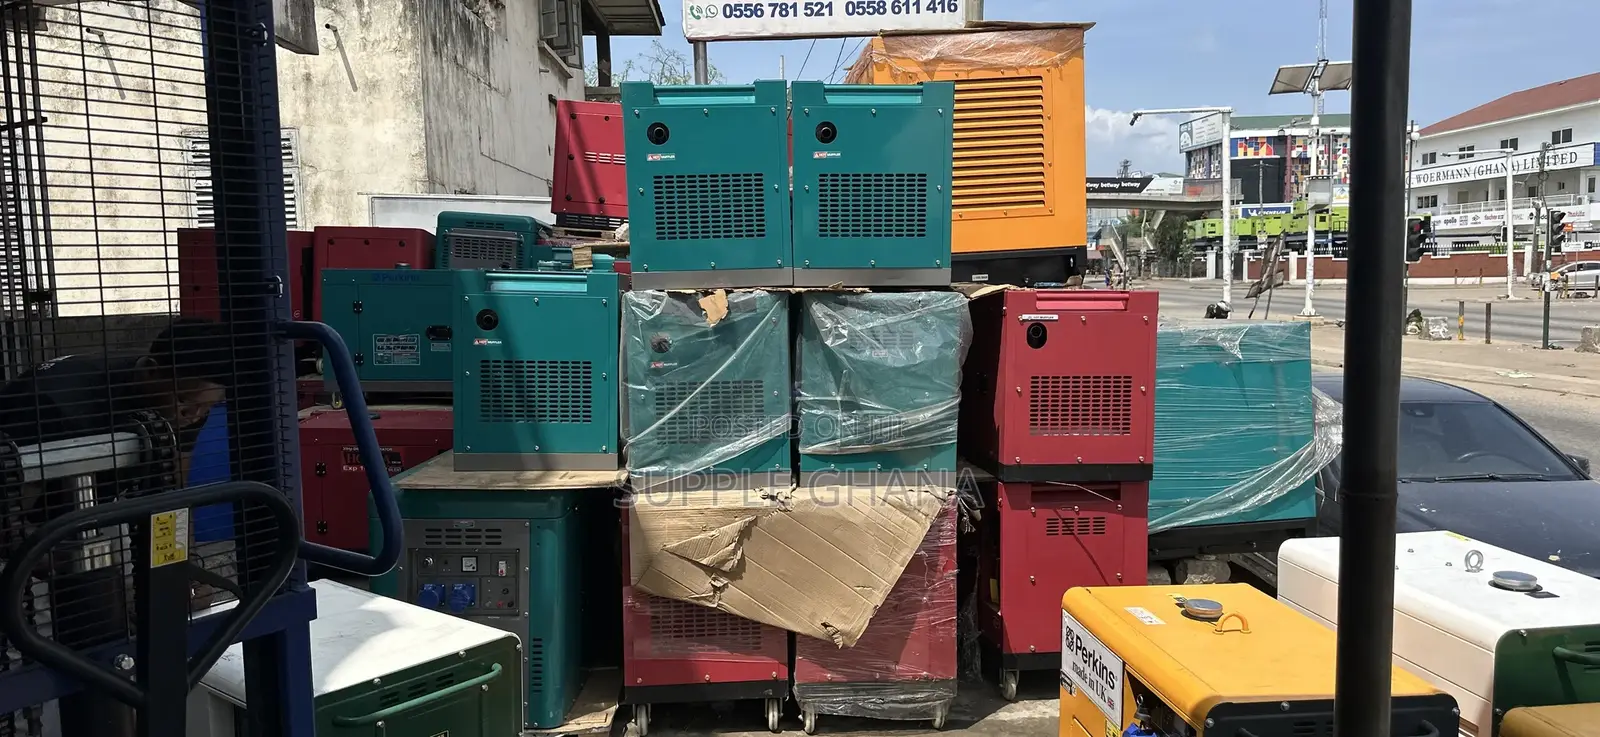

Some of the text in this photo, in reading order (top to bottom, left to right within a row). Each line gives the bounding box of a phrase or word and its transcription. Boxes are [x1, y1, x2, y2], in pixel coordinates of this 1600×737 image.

[722, 0, 958, 19] 0556 781 521 0558 611 416
[1415, 166, 1472, 184] WOERMANN
[1075, 633, 1116, 690] Perkins
[1072, 661, 1088, 684] made
[1088, 672, 1095, 691] in
[1095, 680, 1107, 703] UK
